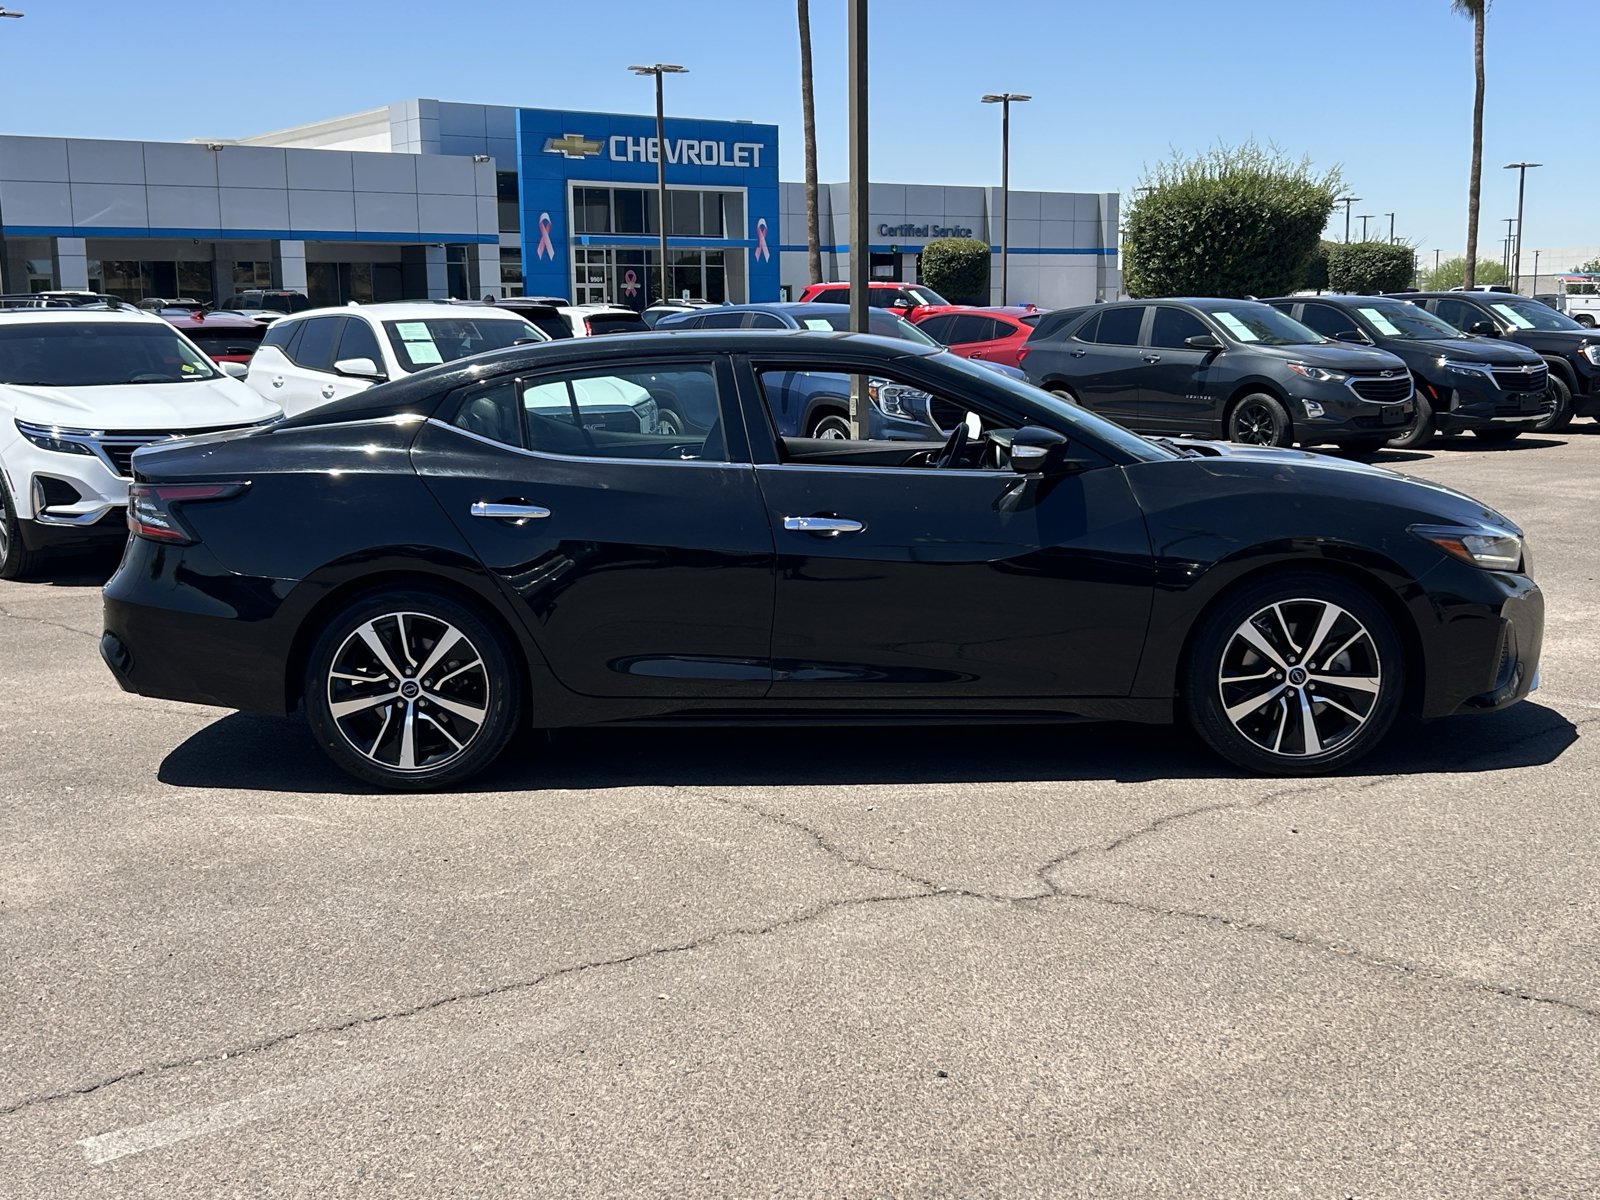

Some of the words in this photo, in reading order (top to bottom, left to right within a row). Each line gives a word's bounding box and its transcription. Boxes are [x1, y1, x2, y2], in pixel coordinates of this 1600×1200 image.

[609, 135, 764, 168] CHEVROLET
[879, 224, 929, 237] Certified
[932, 225, 973, 238] Service
